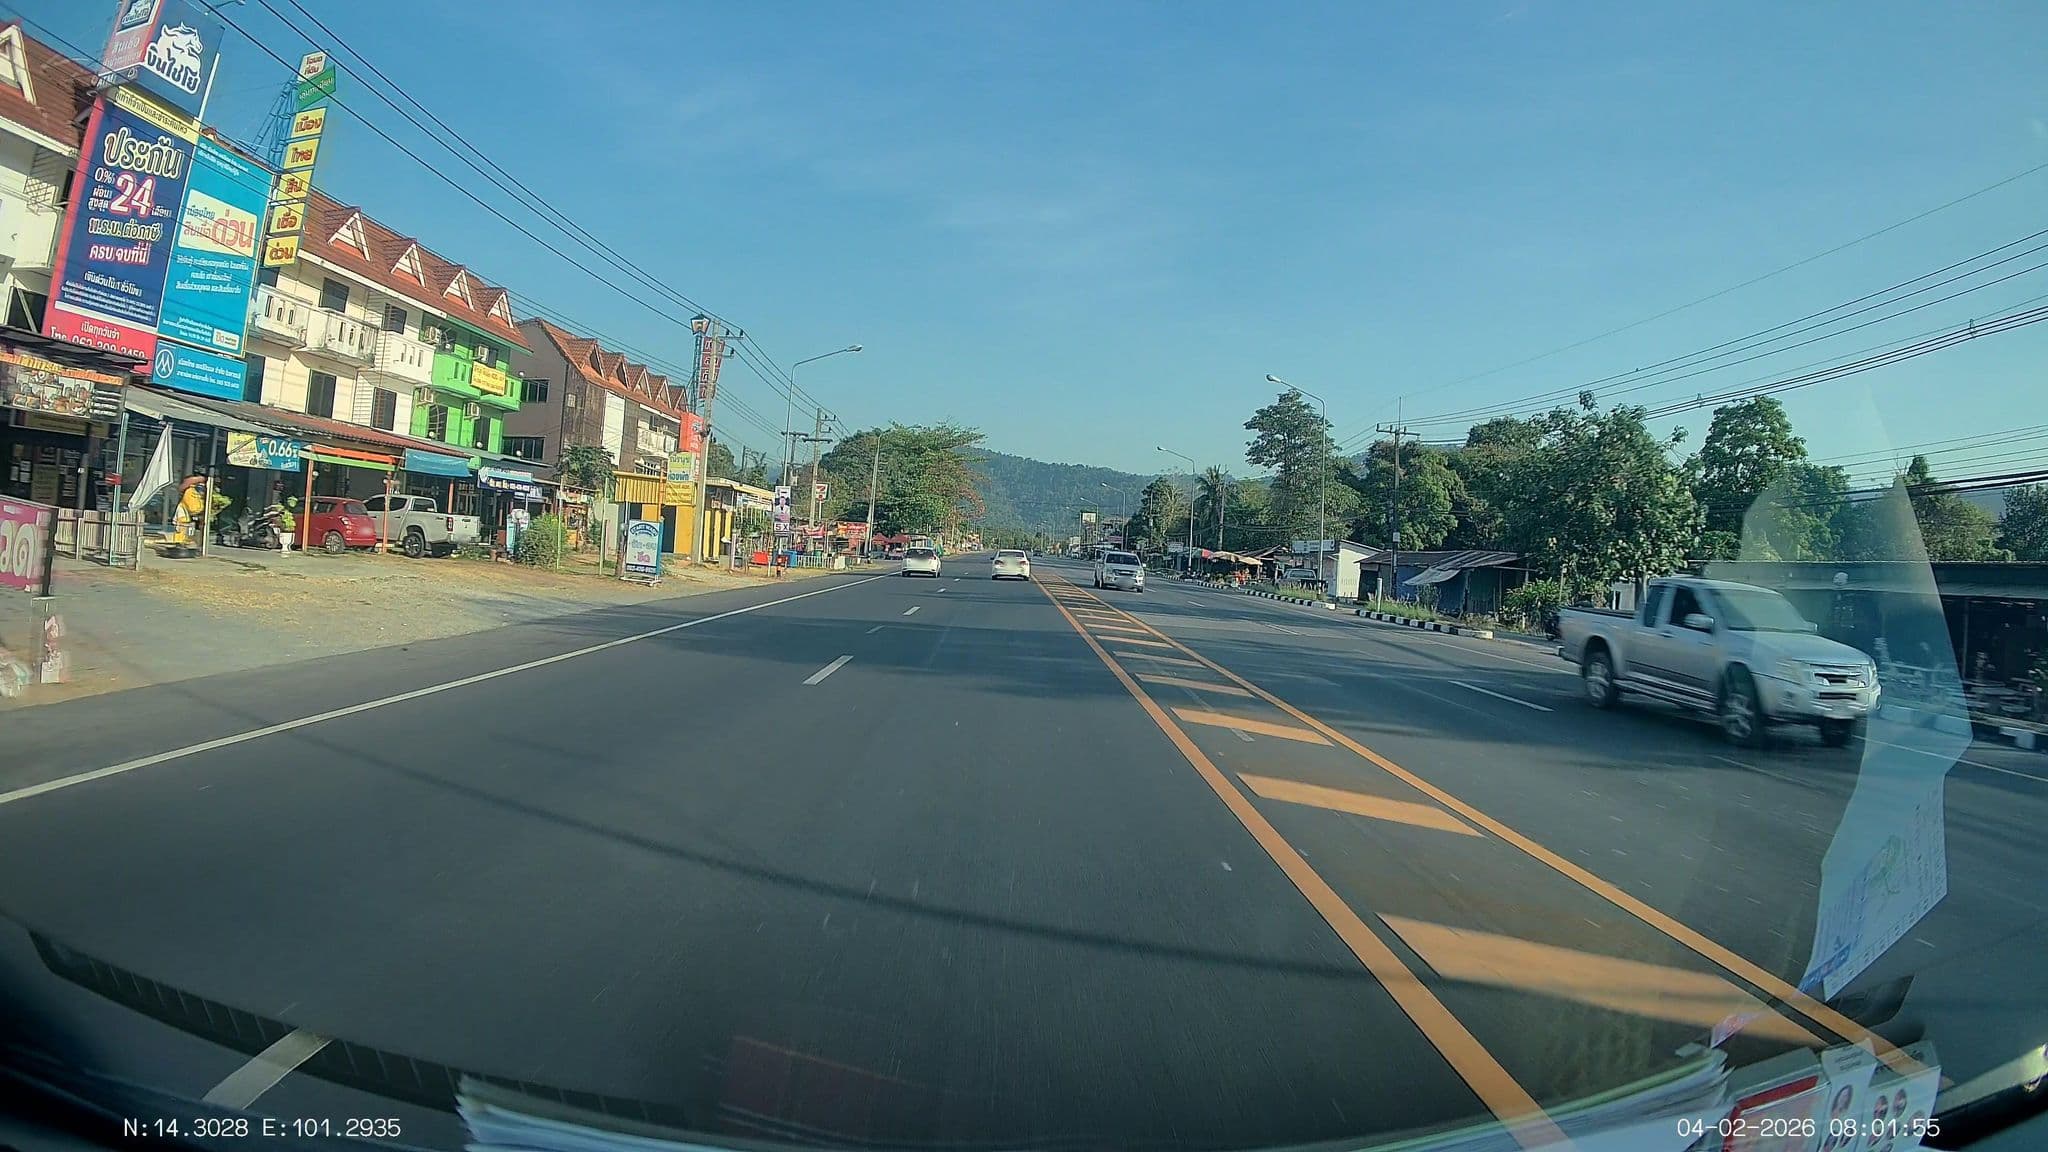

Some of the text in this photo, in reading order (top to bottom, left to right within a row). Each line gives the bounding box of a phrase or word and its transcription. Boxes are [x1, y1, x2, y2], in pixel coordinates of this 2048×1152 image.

[294, 115, 323, 132] เมือง
[104, 127, 184, 178] ประกัน
[290, 146, 313, 163] ไทย
[95, 167, 115, 184] 0%
[92, 185, 112, 199] ผ่อน
[110, 172, 155, 216] 24
[284, 177, 303, 194] สิน
[88, 197, 109, 212] สูงสุด
[186, 204, 216, 221] เมืองไทย
[89, 217, 121, 236] พ.ร.บ.
[276, 207, 298, 229] เชื่อ
[211, 208, 256, 248] ด่วน
[89, 241, 151, 265] ครบ จบที่นี่
[268, 241, 294, 260] ด่วน
